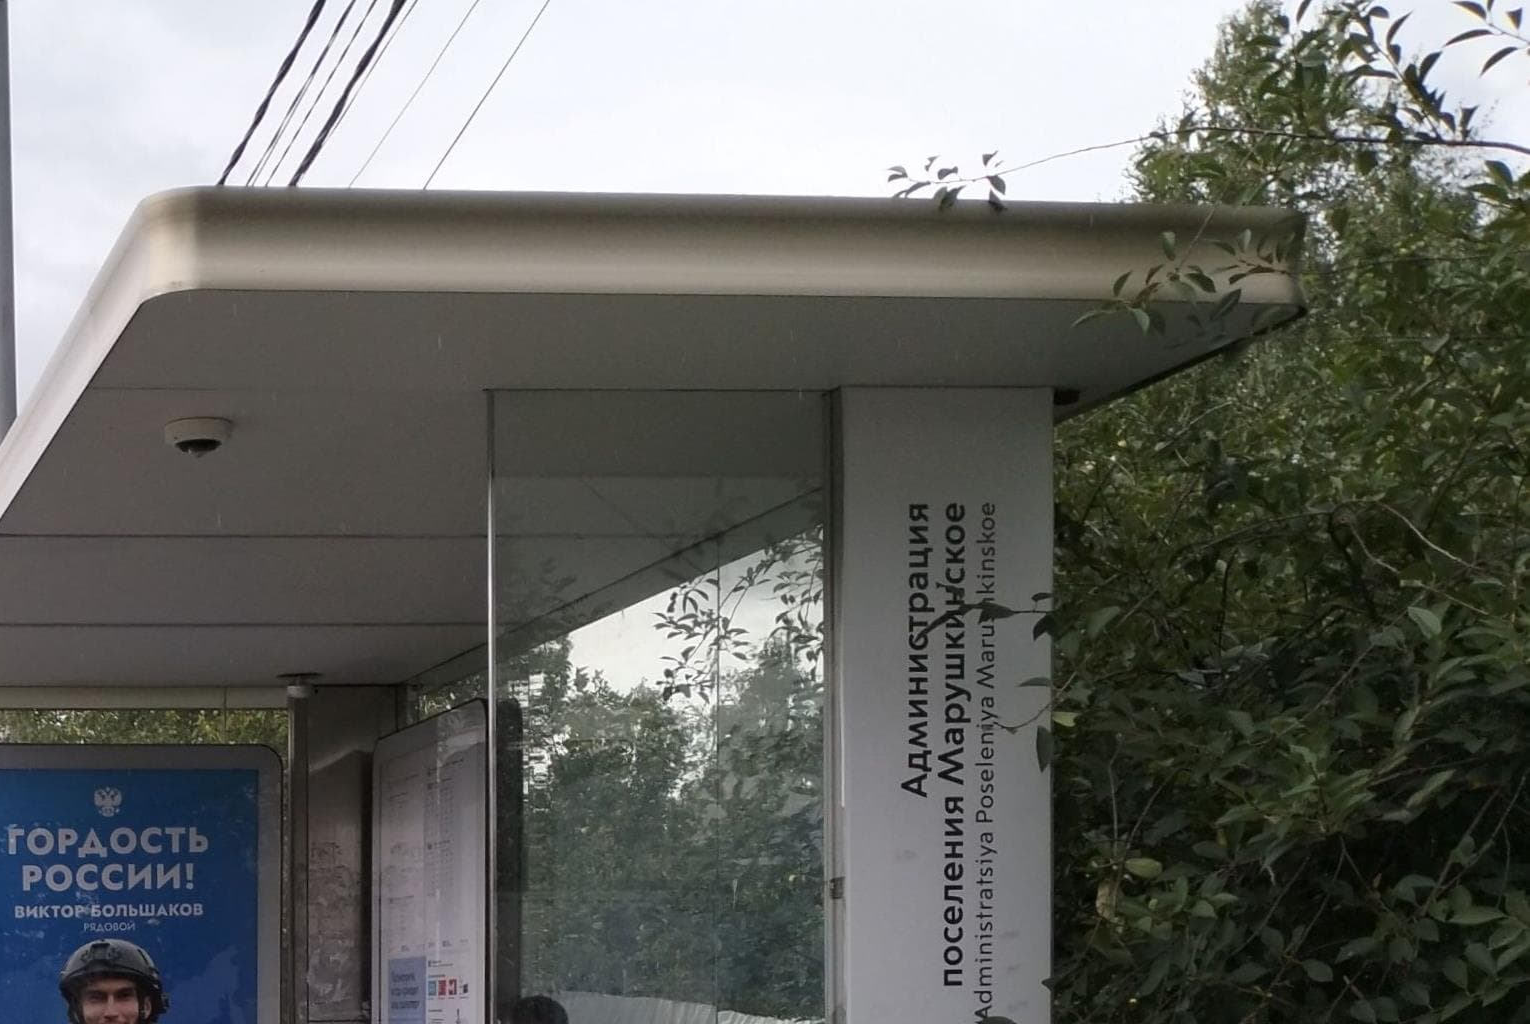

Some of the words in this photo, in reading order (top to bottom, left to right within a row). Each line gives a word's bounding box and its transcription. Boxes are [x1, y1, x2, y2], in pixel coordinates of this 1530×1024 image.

[900, 503, 936, 799] Администрация
[937, 502, 972, 786] Марушкинское
[975, 502, 996, 689] Marukinskoe
[975, 696, 999, 823] Poseleniya
[7, 826, 209, 858] ГОРДОСТЬ
[14, 904, 86, 919] ВИКТОР
[90, 903, 204, 918] БОЛЬШАКОВ
[22, 862, 195, 892] РОССИИ!
[943, 796, 965, 986] поселения
[83, 921, 136, 932] РЯДОВОЙ
[974, 832, 998, 1021] Administratsiya
